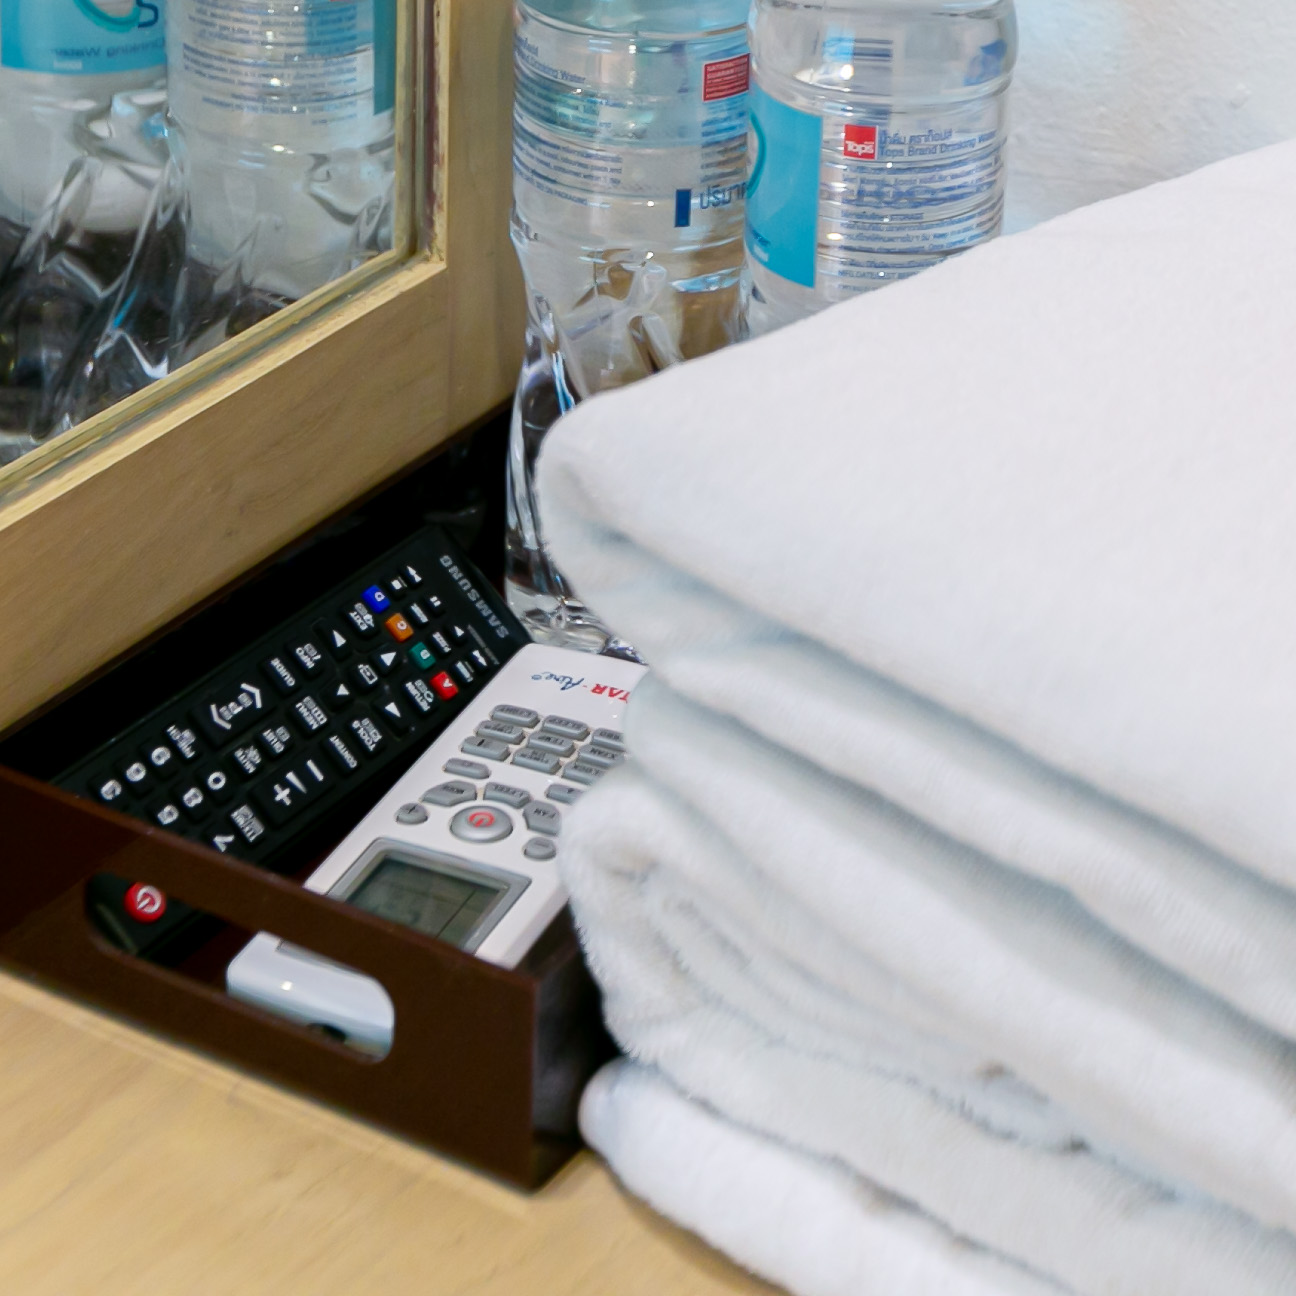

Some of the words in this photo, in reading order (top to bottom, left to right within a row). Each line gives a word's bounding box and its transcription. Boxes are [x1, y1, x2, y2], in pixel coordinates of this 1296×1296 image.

[845, 141, 875, 156] Tops
[879, 147, 904, 159] Tops
[908, 144, 937, 156] Brand
[940, 138, 977, 151] Drinking
[439, 555, 509, 639] SAMSUNG
[349, 610, 369, 631] EXIT
[270, 657, 296, 687] GUIDE
[590, 683, 631, 704] TAR
[295, 702, 320, 730] MENU
[351, 720, 376, 752] TOOLS
[151, 746, 171, 767] 9
[329, 735, 358, 769] CONTENT
[125, 762, 147, 782] 6
[100, 779, 122, 801] 3
[182, 787, 204, 808] 8
[157, 804, 180, 826] 5
[213, 834, 235, 853] 7
